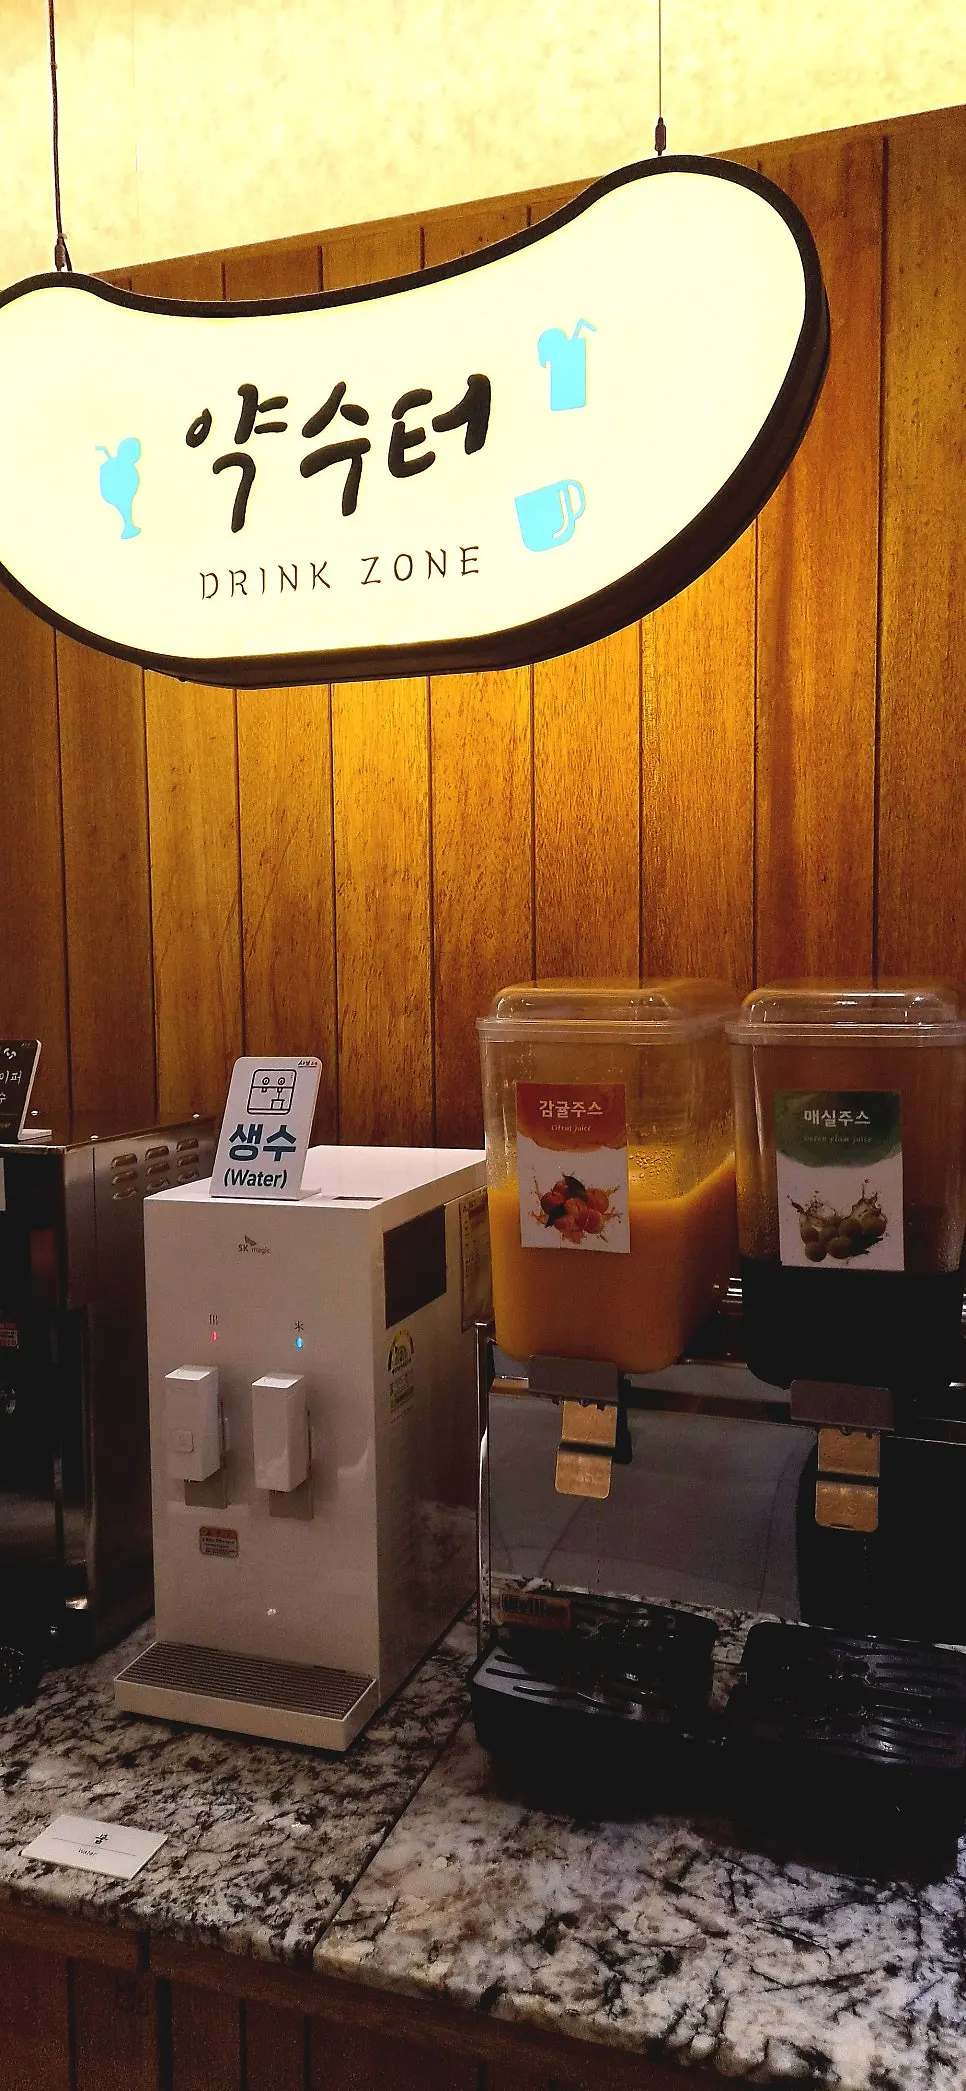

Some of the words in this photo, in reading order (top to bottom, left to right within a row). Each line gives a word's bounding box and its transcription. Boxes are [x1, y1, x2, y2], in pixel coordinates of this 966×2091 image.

[186, 374, 491, 533] 약수터
[200, 561, 331, 599] DRINK
[361, 546, 479, 585] ZONE
[539, 1100, 603, 1118] 감귤주스
[803, 1109, 871, 1127] 매실주스
[228, 1123, 297, 1162] 생수
[224, 1167, 288, 1189] (Water)
[238, 1243, 249, 1252] SK
